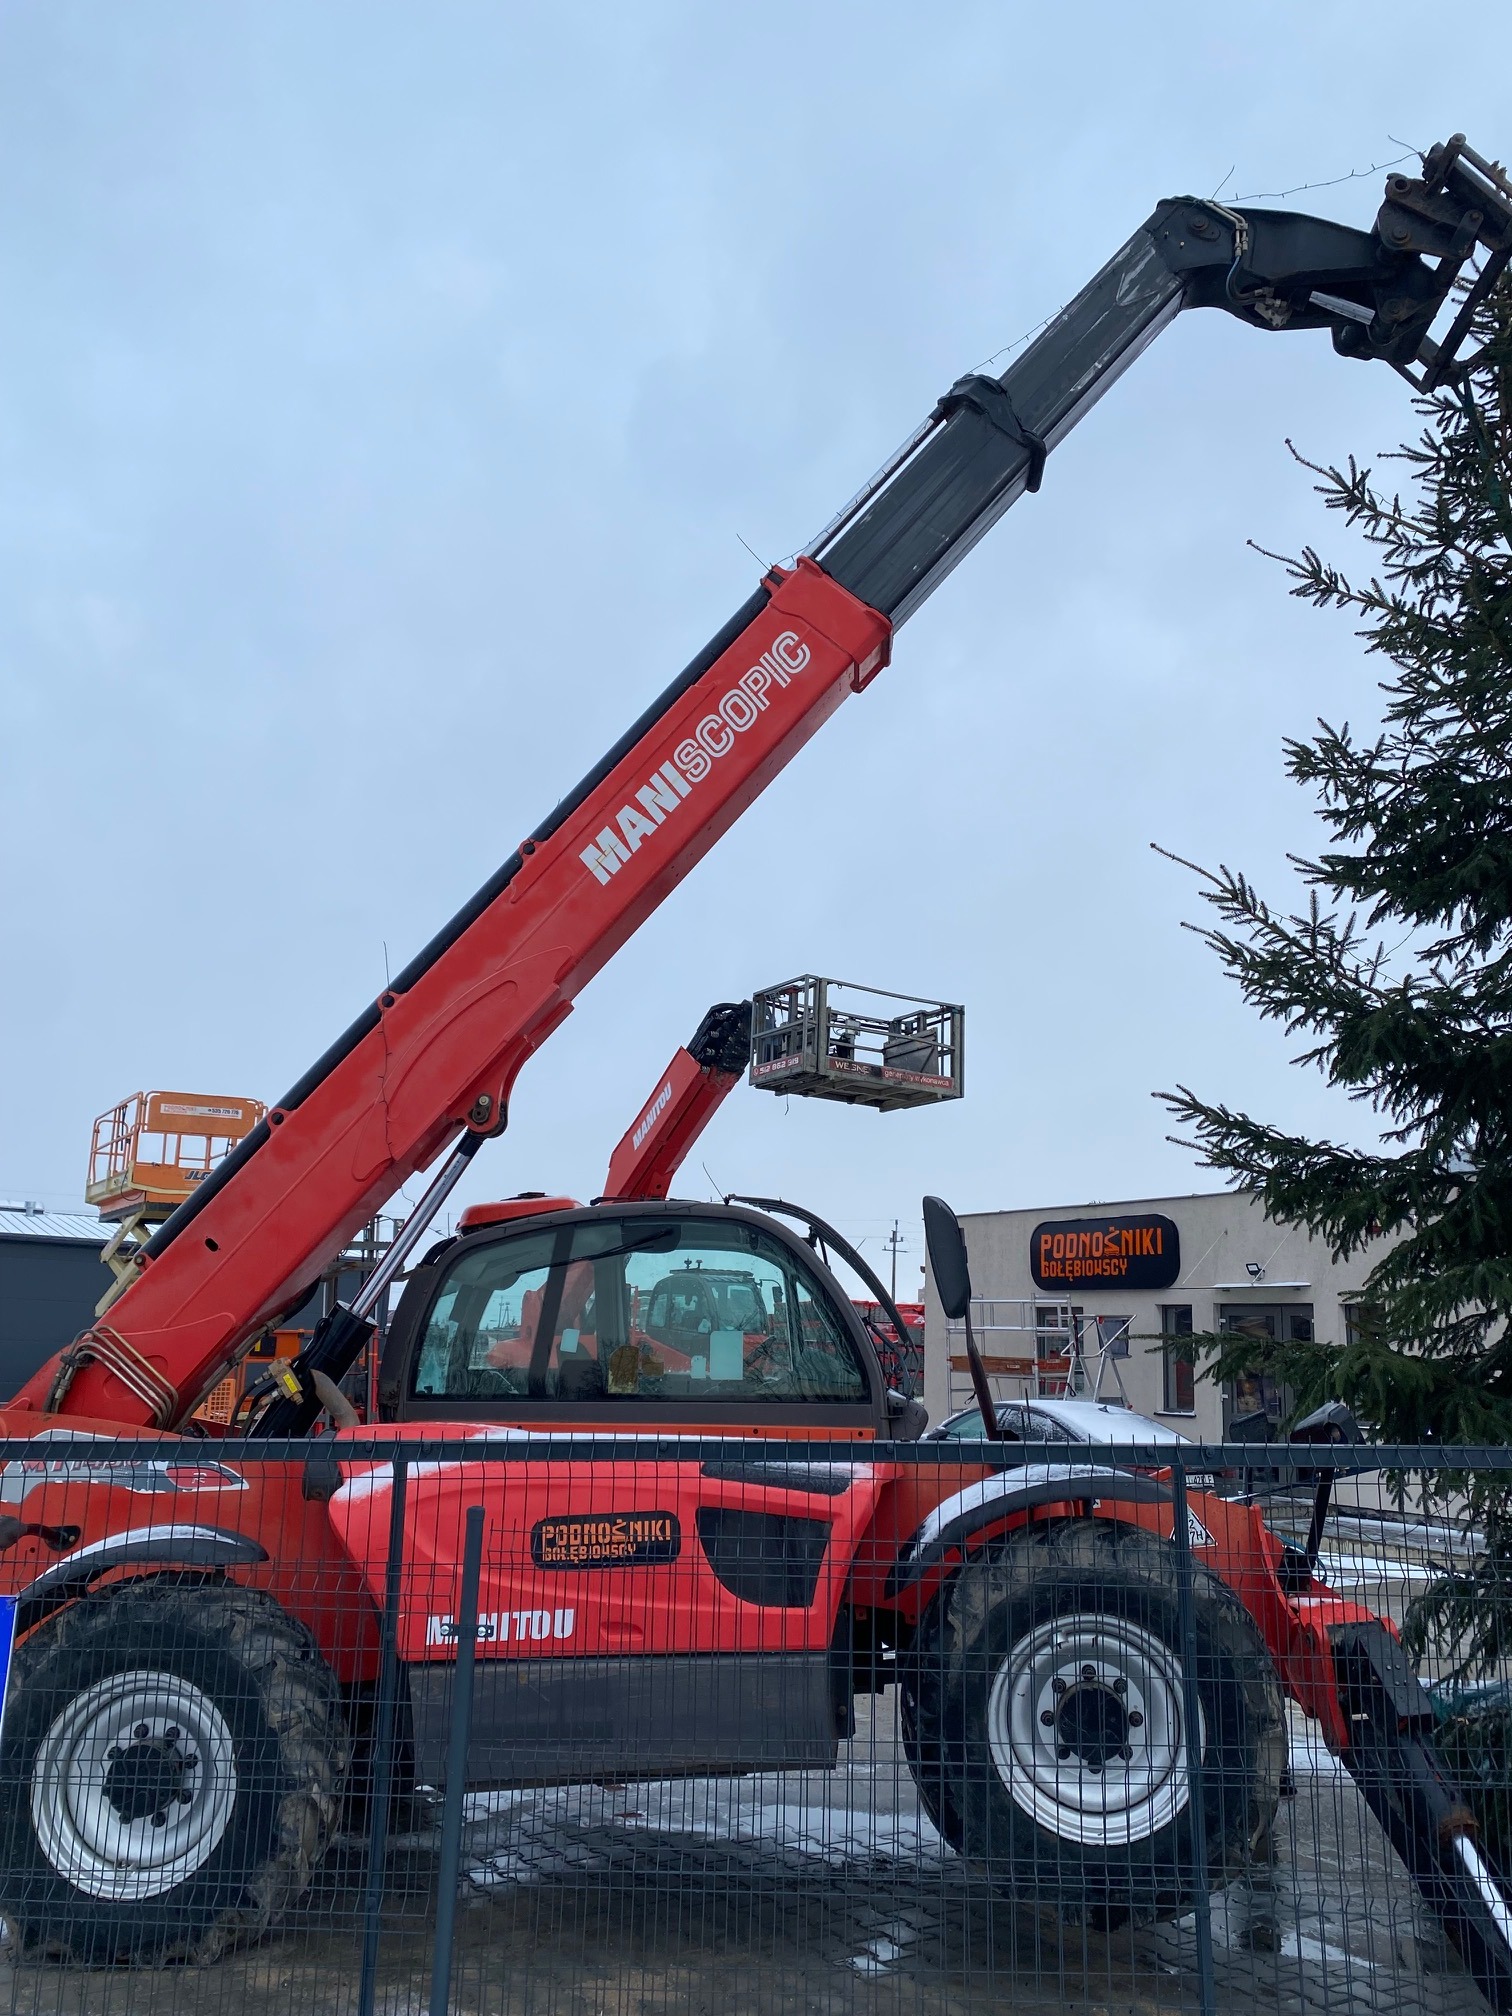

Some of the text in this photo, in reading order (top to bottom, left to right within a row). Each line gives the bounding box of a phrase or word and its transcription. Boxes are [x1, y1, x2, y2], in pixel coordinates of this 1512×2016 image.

[579, 631, 811, 886] MANISCOPIC
[632, 1081, 672, 1152] MANITOU
[1040, 1258, 1128, 1282] GOŁĘBIOWSCY
[426, 1608, 575, 1646] MNITOU
